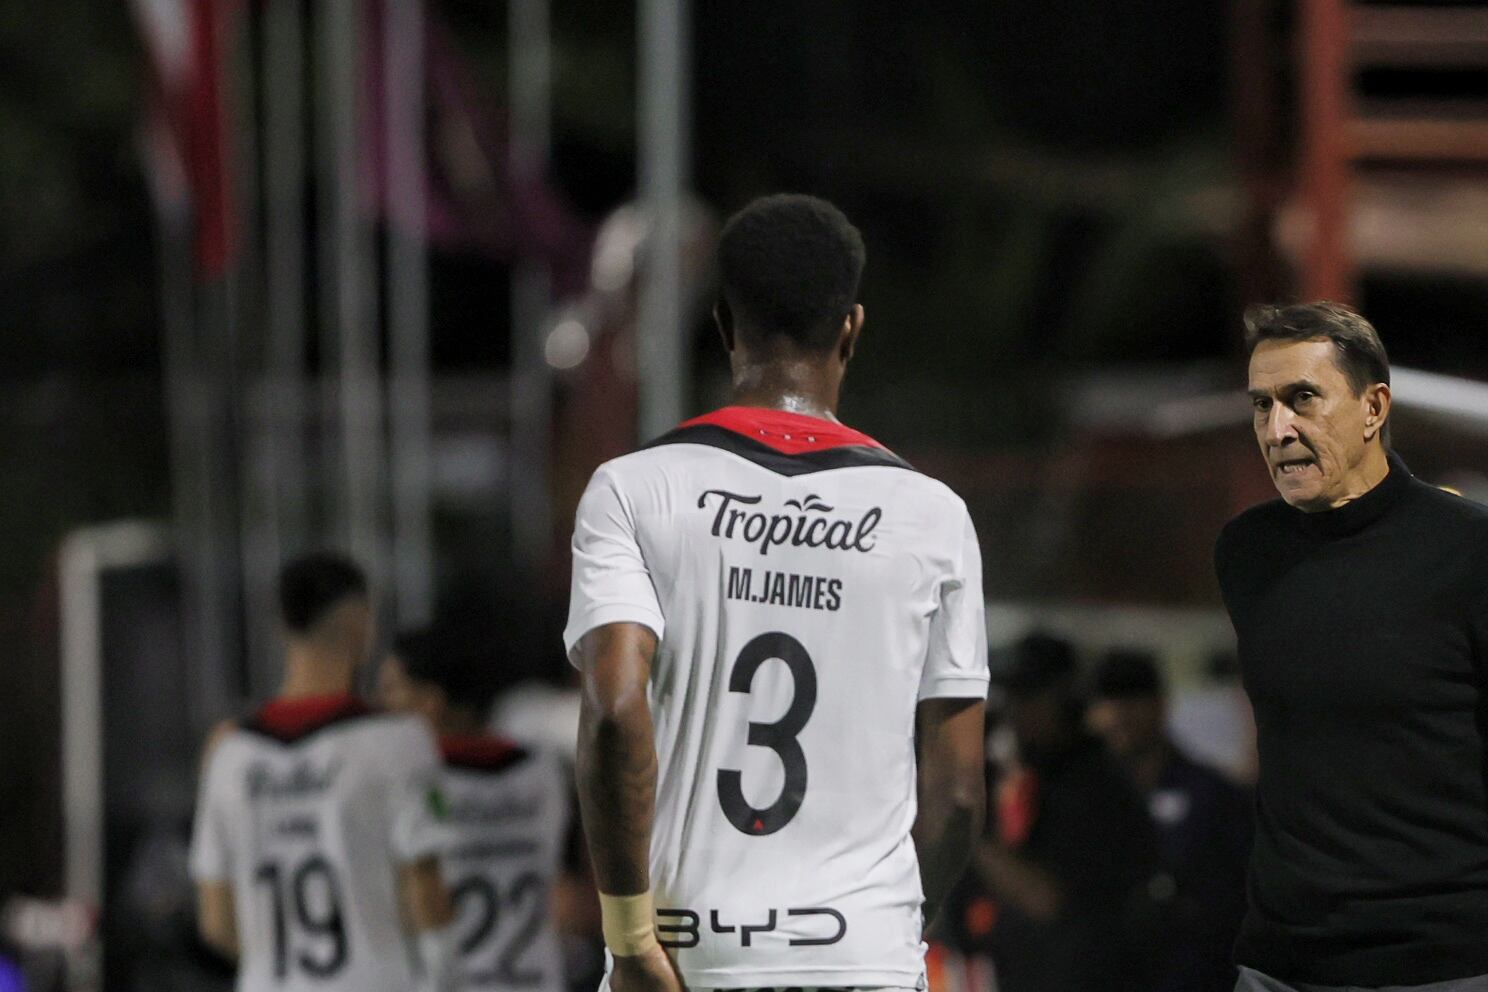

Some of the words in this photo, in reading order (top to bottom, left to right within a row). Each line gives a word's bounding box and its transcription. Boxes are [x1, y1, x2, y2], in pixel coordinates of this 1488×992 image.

[697, 490, 883, 555] Tropical
[727, 566, 843, 612] M.JAMES
[716, 631, 818, 837] 3
[252, 856, 349, 981] 19
[450, 870, 545, 989] 22
[656, 907, 847, 948] BYD
